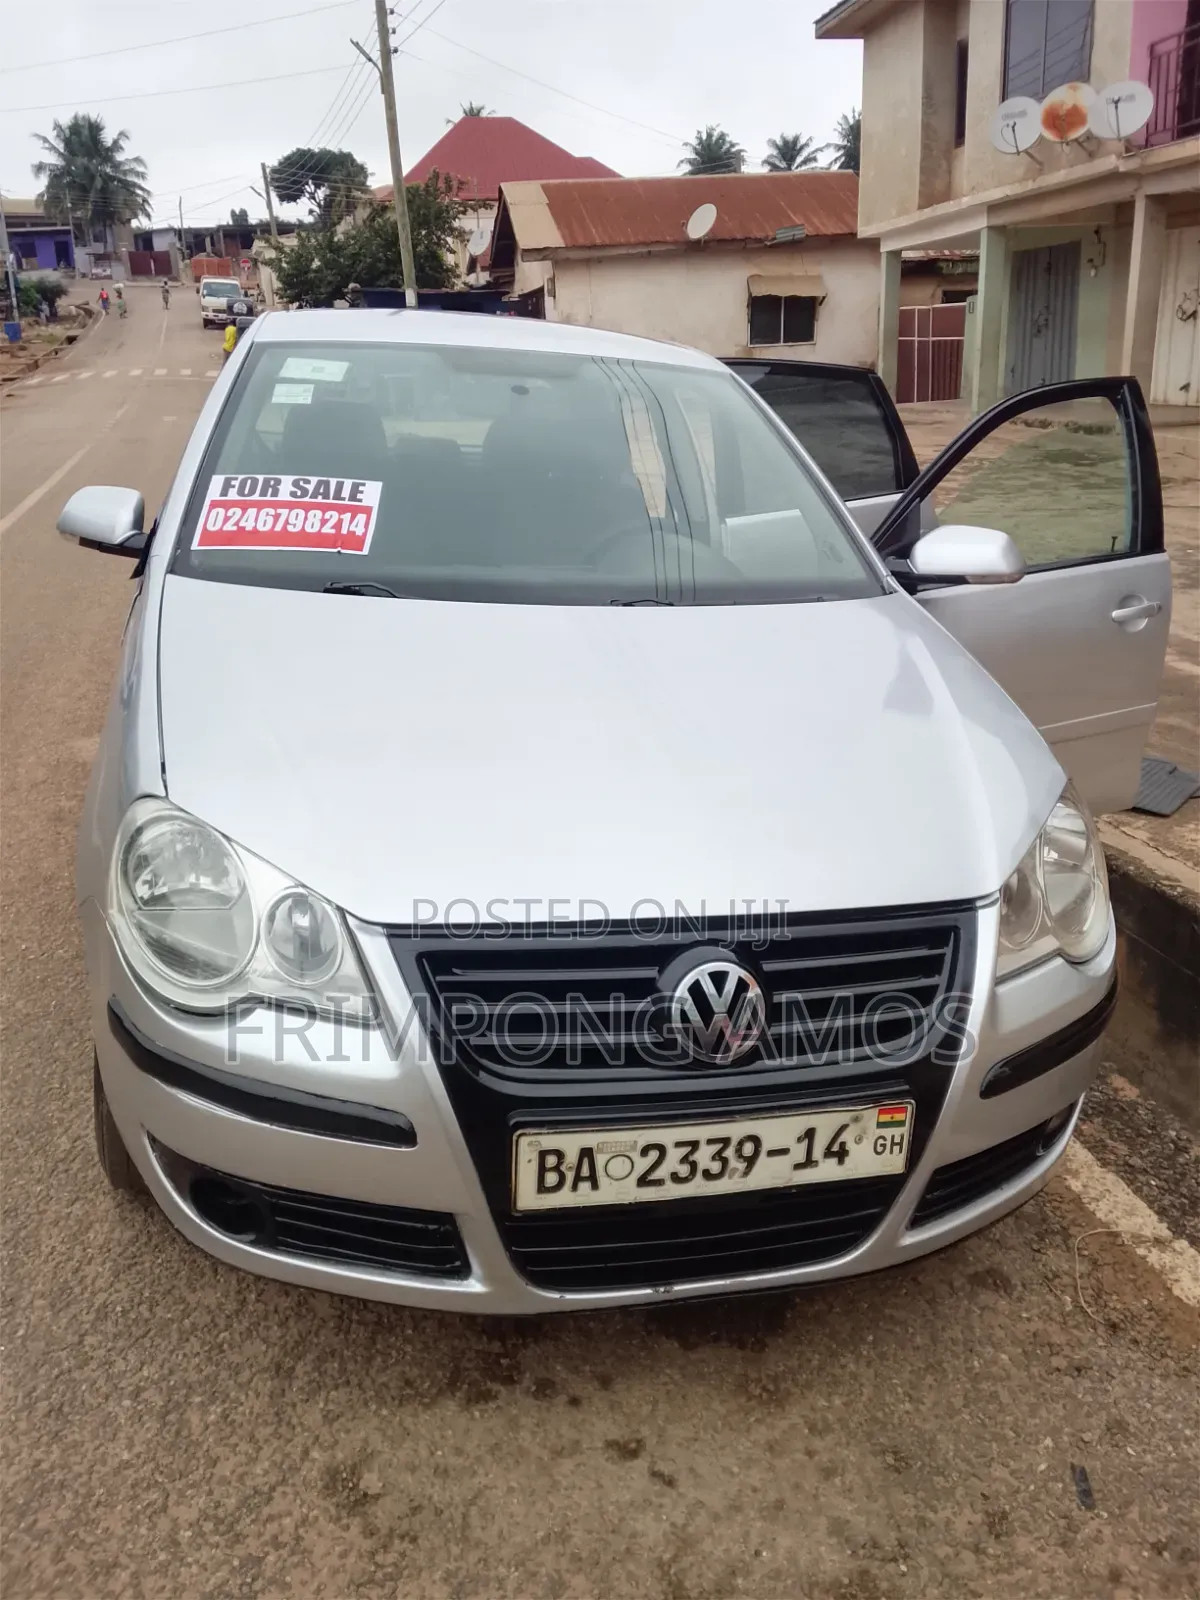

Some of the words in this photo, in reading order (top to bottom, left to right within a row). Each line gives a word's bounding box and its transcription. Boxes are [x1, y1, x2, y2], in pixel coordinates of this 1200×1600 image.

[219, 476, 282, 498] FOR
[289, 477, 366, 503] SALE
[206, 507, 367, 536] 0246798214
[873, 1133, 905, 1156] GH
[536, 1147, 600, 1195] BA
[636, 1123, 851, 1187] 2339-14
